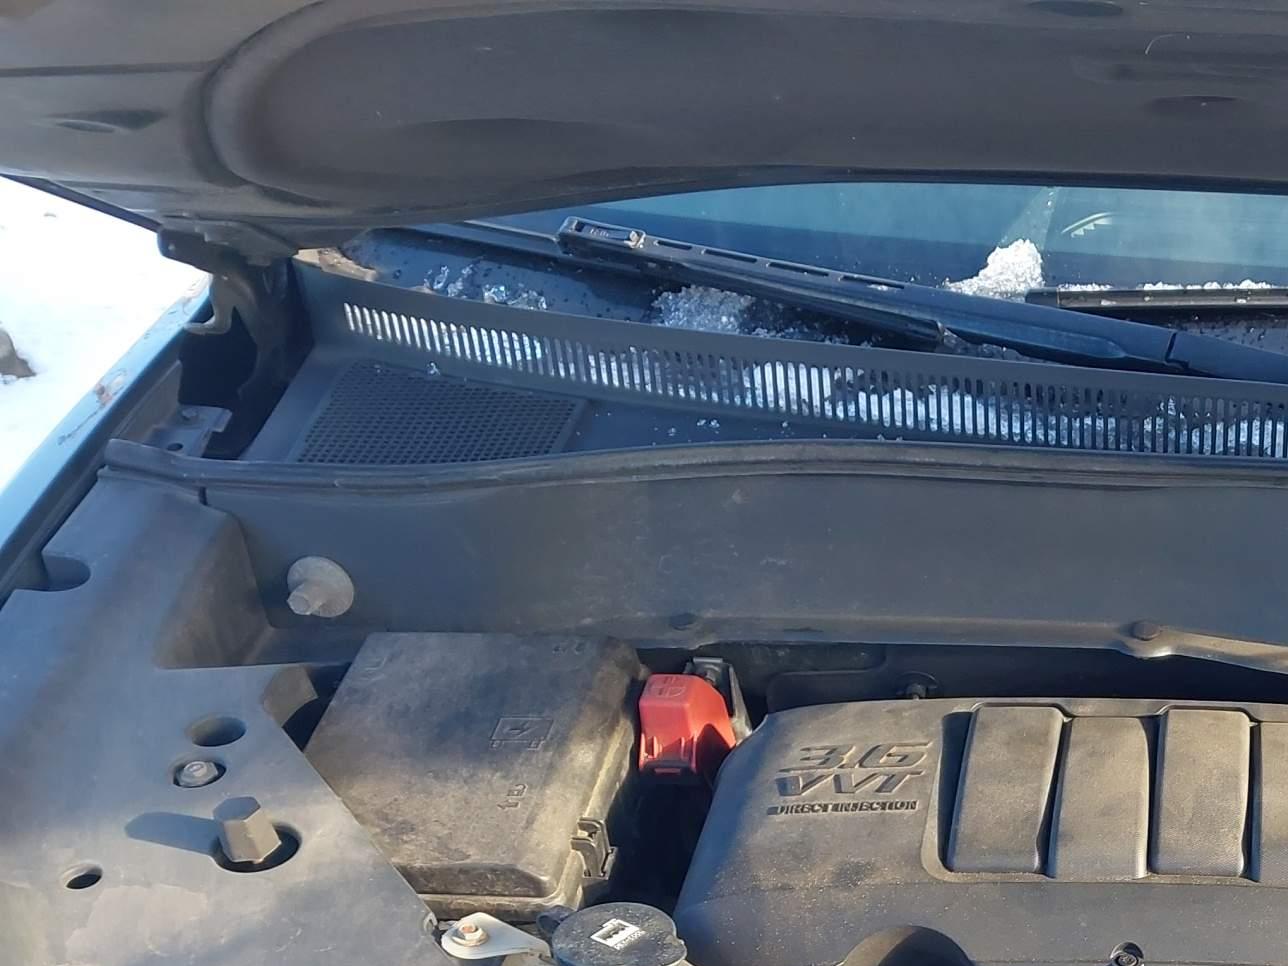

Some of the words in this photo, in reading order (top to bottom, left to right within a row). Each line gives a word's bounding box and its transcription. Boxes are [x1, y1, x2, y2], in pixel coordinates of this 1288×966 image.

[778, 741, 933, 772] 3.6
[774, 770, 925, 797] VVT
[773, 801, 832, 815] DIRECT
[834, 799, 919, 814] INJECTION
